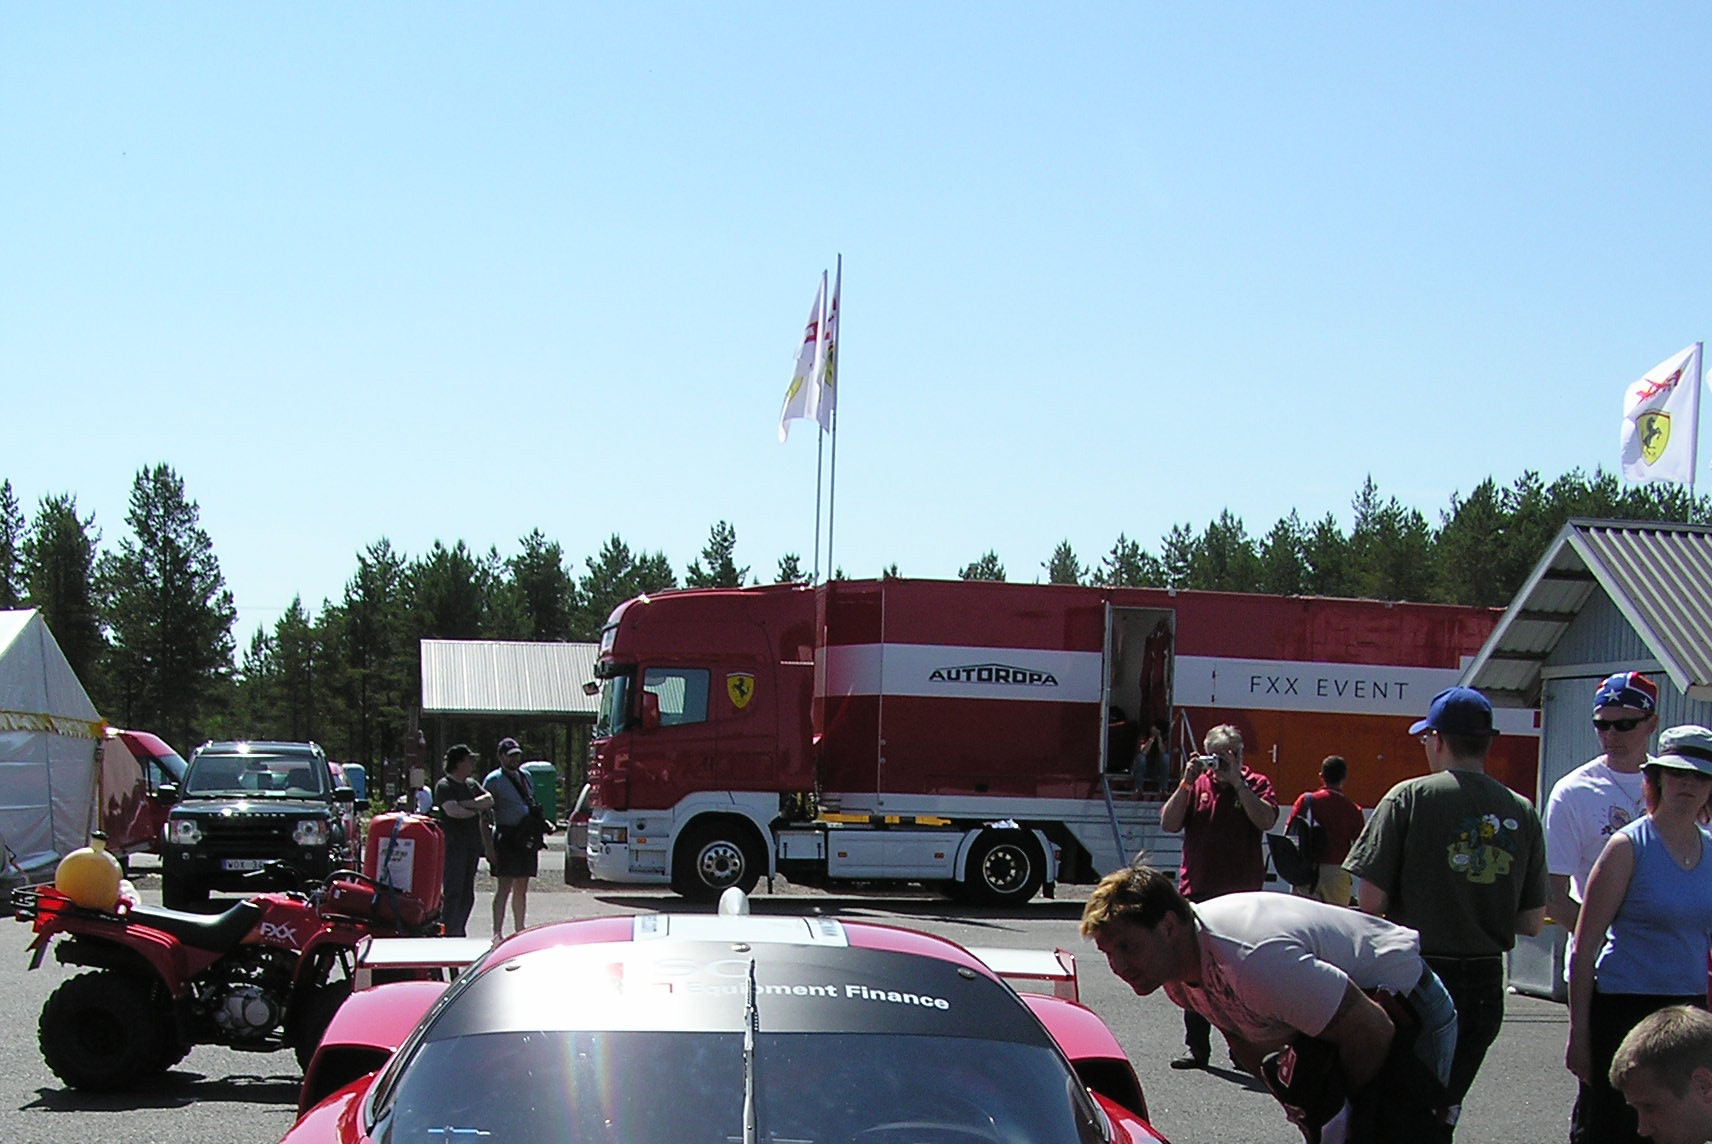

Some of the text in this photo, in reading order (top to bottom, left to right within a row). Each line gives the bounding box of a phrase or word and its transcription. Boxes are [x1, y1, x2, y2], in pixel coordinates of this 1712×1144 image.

[929, 667, 1059, 687] AUTOROPA
[1250, 675, 1409, 700] FXX EVENT
[844, 984, 950, 1010] Finance
